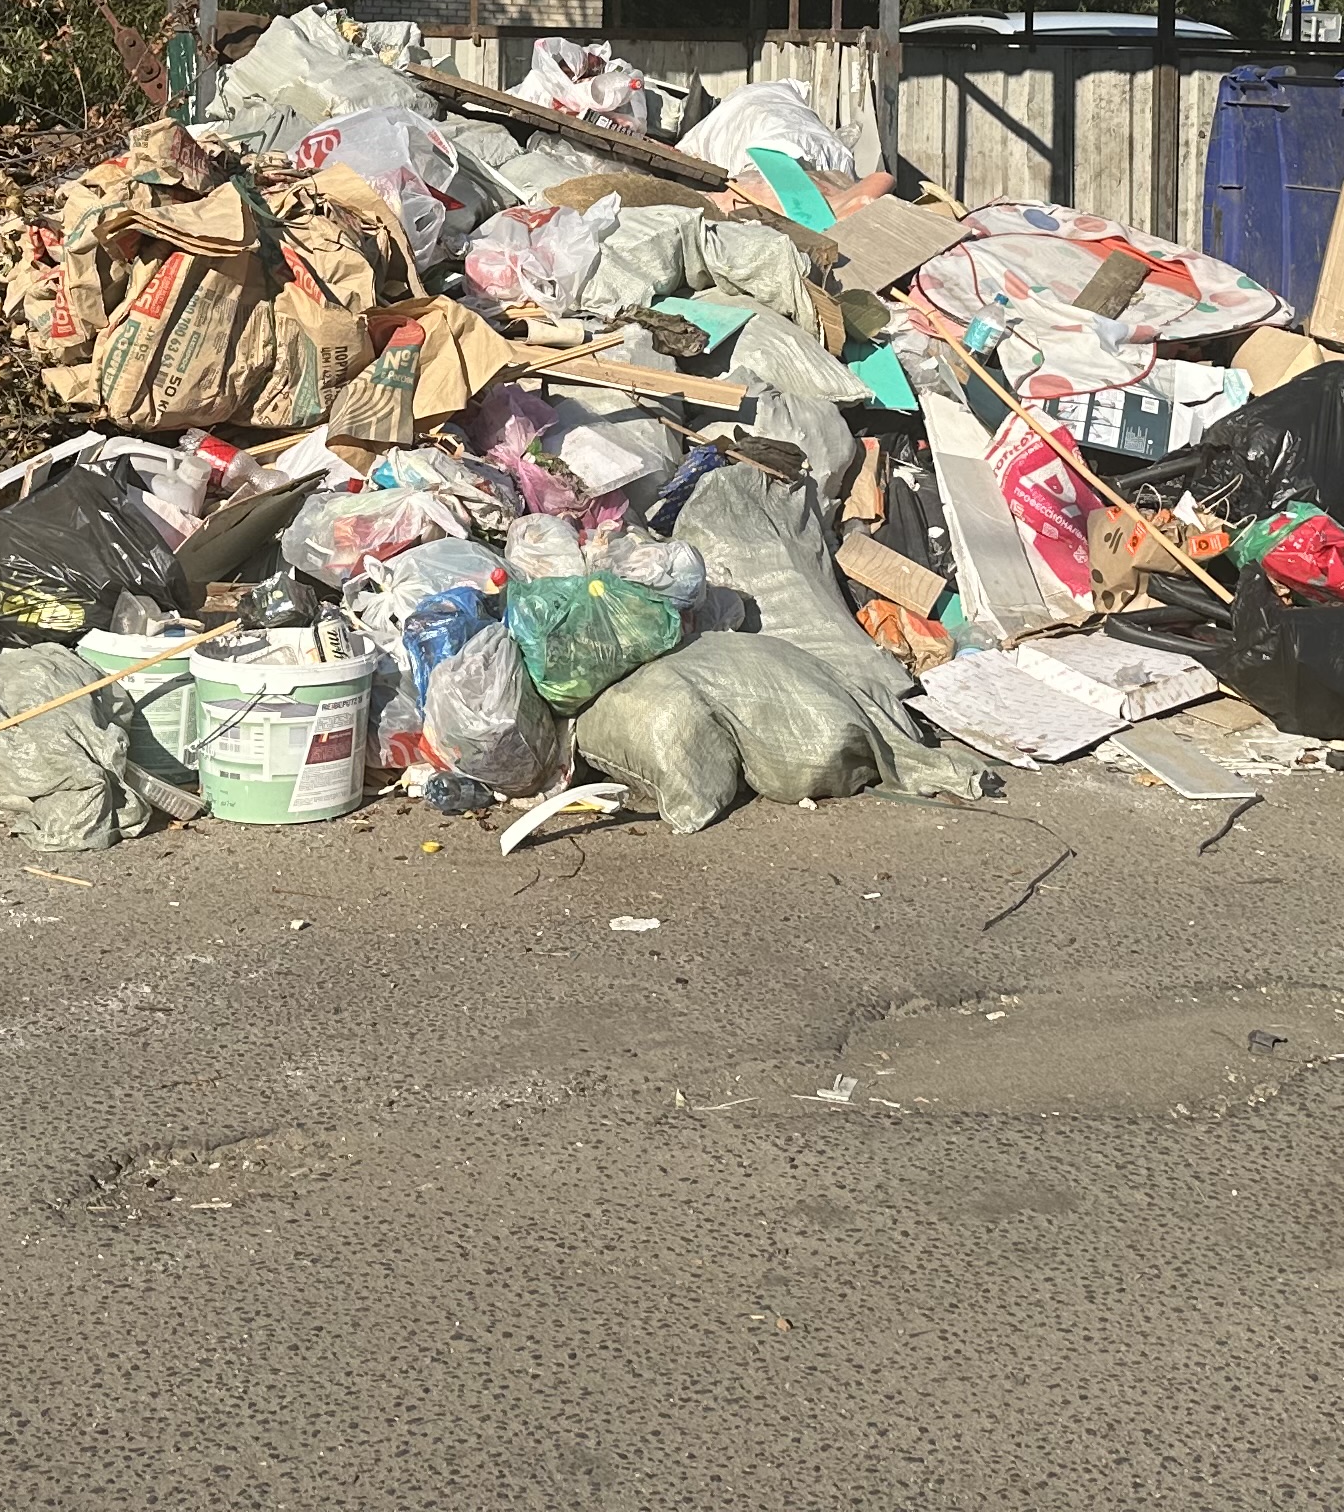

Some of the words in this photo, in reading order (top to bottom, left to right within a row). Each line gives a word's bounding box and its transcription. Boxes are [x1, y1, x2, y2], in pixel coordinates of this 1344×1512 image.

[135, 344, 150, 362] 50
[167, 338, 182, 353] 63
[382, 349, 420, 374] №1
[164, 373, 183, 398] 50
